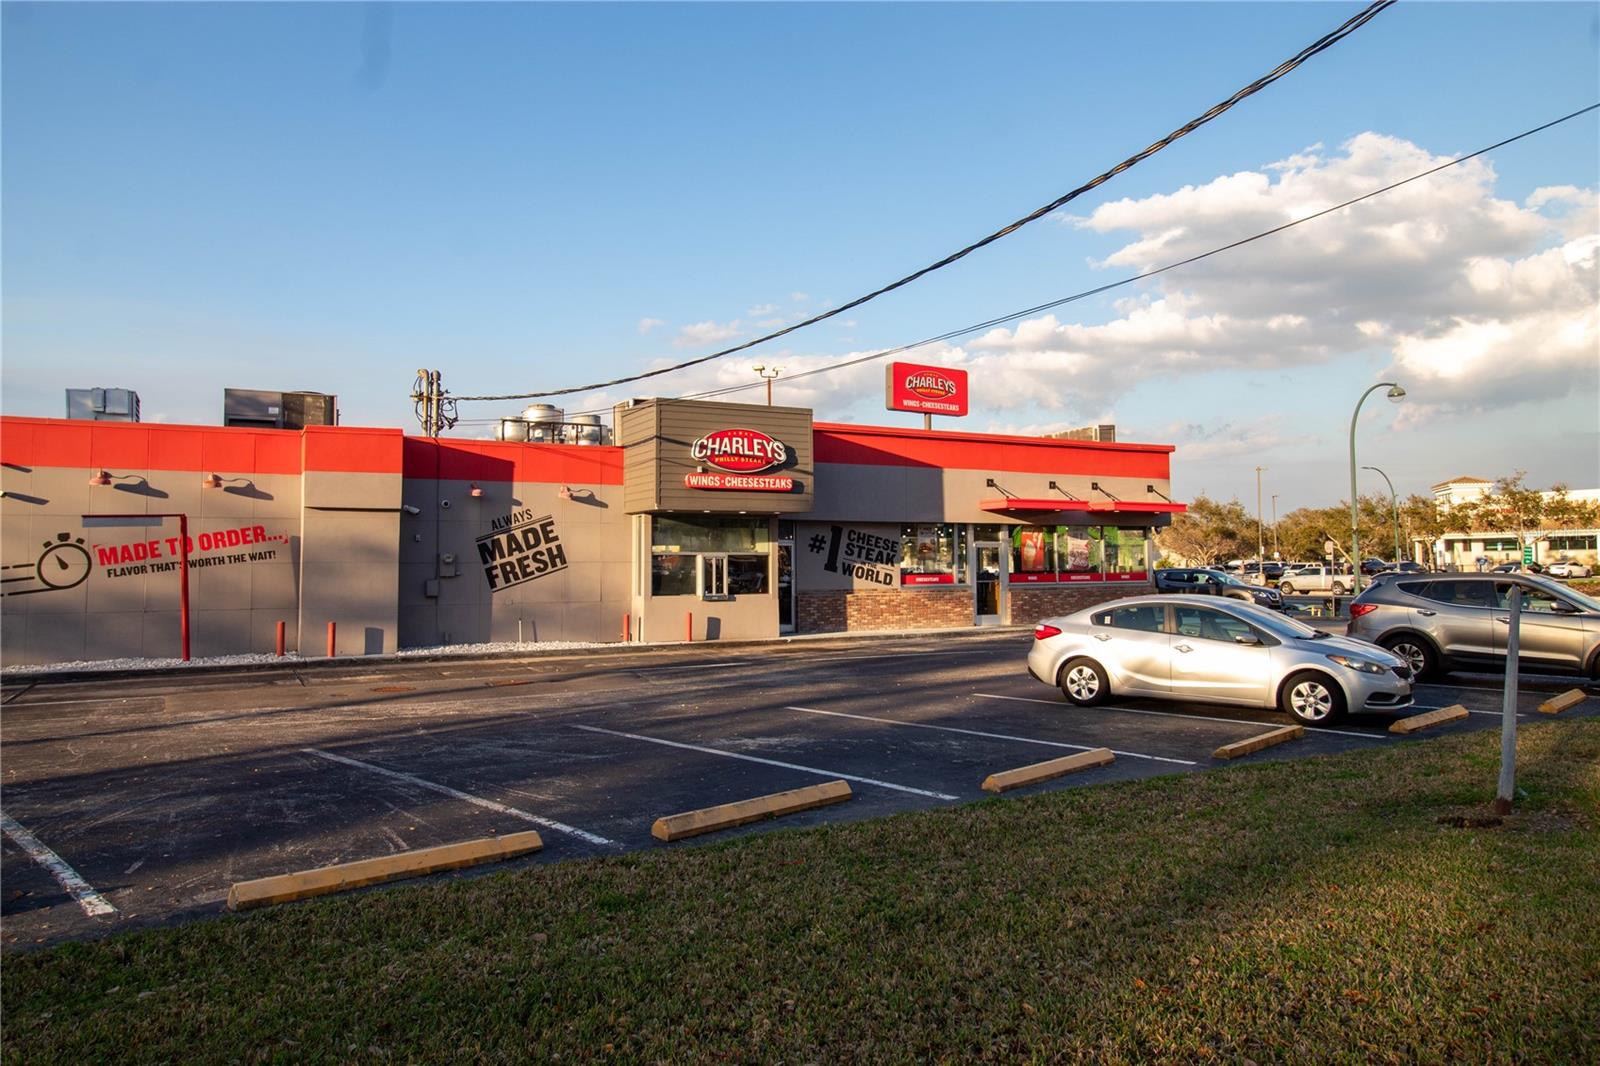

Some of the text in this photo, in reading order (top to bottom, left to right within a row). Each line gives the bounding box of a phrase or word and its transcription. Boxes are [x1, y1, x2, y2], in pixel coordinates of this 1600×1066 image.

[905, 376, 956, 394] CHARLEYS
[693, 437, 787, 461] CHARLEYS
[689, 475, 793, 489] WINGS CHEESESTEAKS
[491, 508, 533, 531] ALWAYS
[97, 541, 162, 566] MADE
[165, 536, 194, 556] TO
[477, 520, 560, 565] MADE
[847, 529, 899, 553] CHEESE
[107, 565, 148, 578] FLAVOR
[188, 556, 225, 568] WORTH
[227, 553, 247, 564] THE
[248, 550, 277, 562] WAIT!
[485, 544, 568, 590] FRESH
[845, 542, 897, 567] STEAK
[842, 561, 894, 586] WORLD
